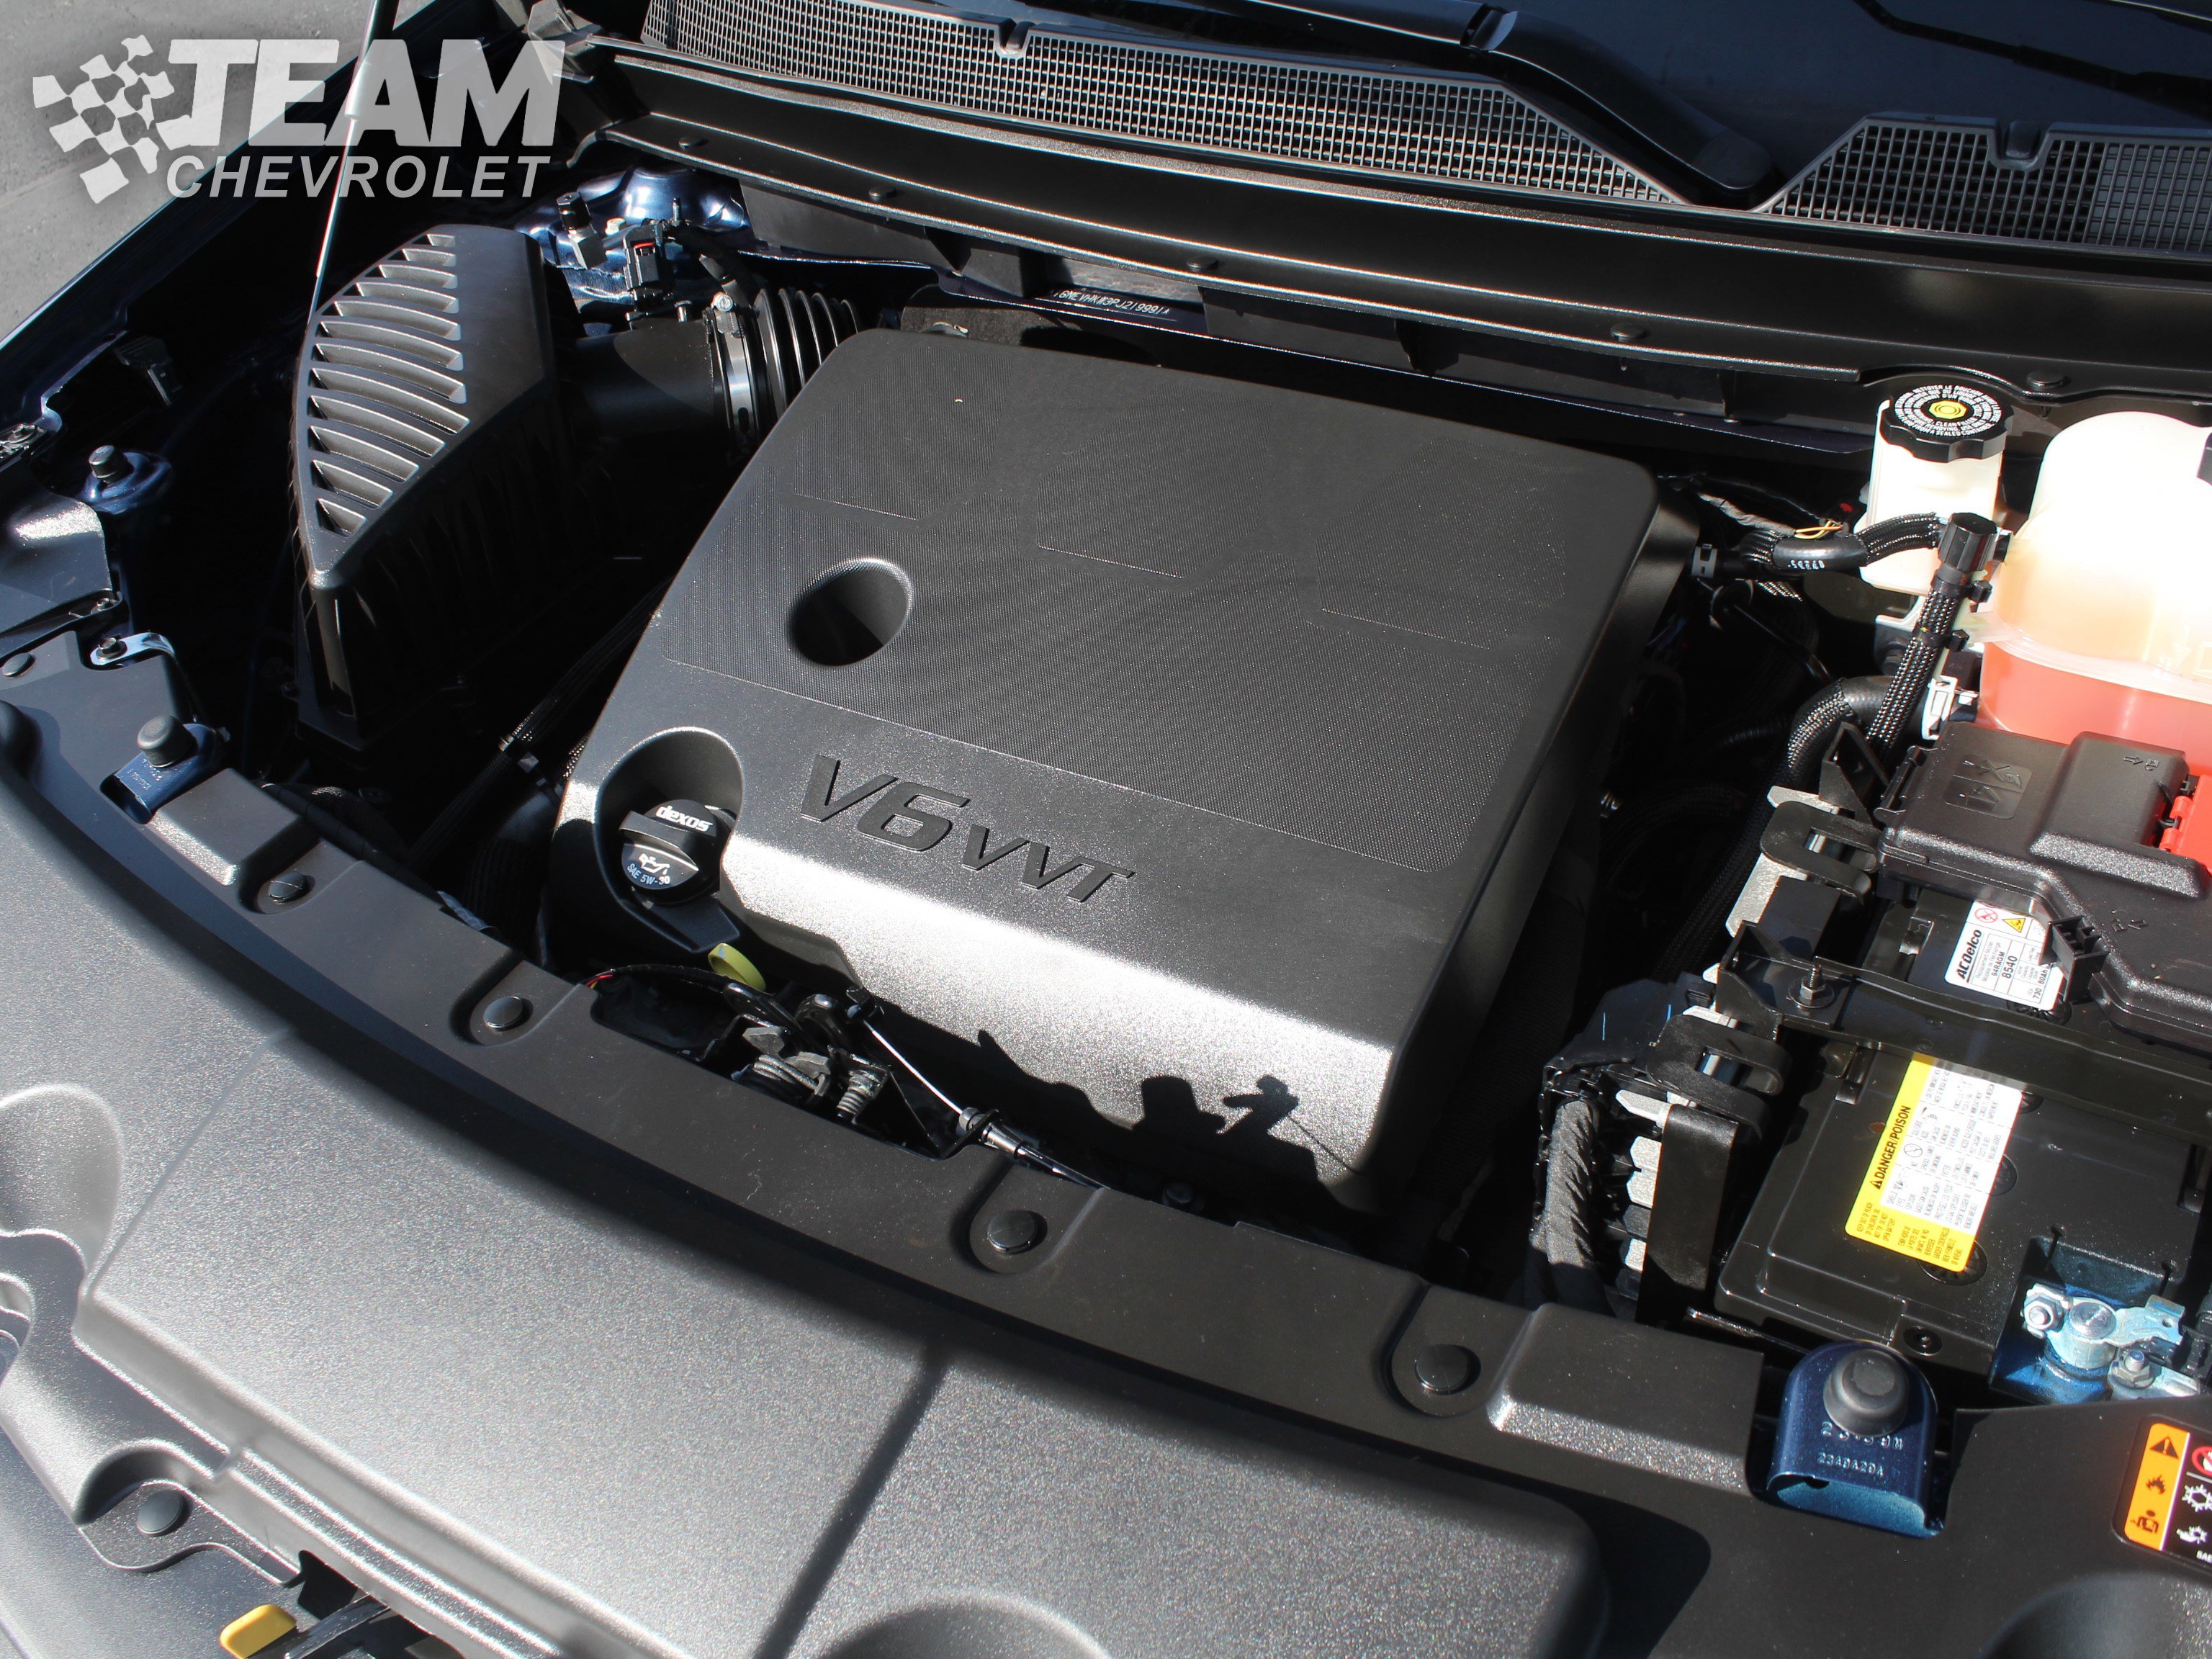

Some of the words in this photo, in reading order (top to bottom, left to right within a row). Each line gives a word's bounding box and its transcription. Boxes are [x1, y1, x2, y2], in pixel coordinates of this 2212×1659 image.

[656, 805, 714, 832] dexos
[801, 754, 971, 852] V6
[962, 823, 1136, 902] VVT
[627, 863, 642, 878] SAE
[640, 876, 670, 885] 5W-30
[1956, 930, 1982, 980] ACDelco
[2002, 956, 2017, 979] 8540
[2038, 969, 2048, 984] 80Ah
[2033, 988, 2042, 999] 730
[1874, 1106, 1911, 1179] DANGER/POISON
